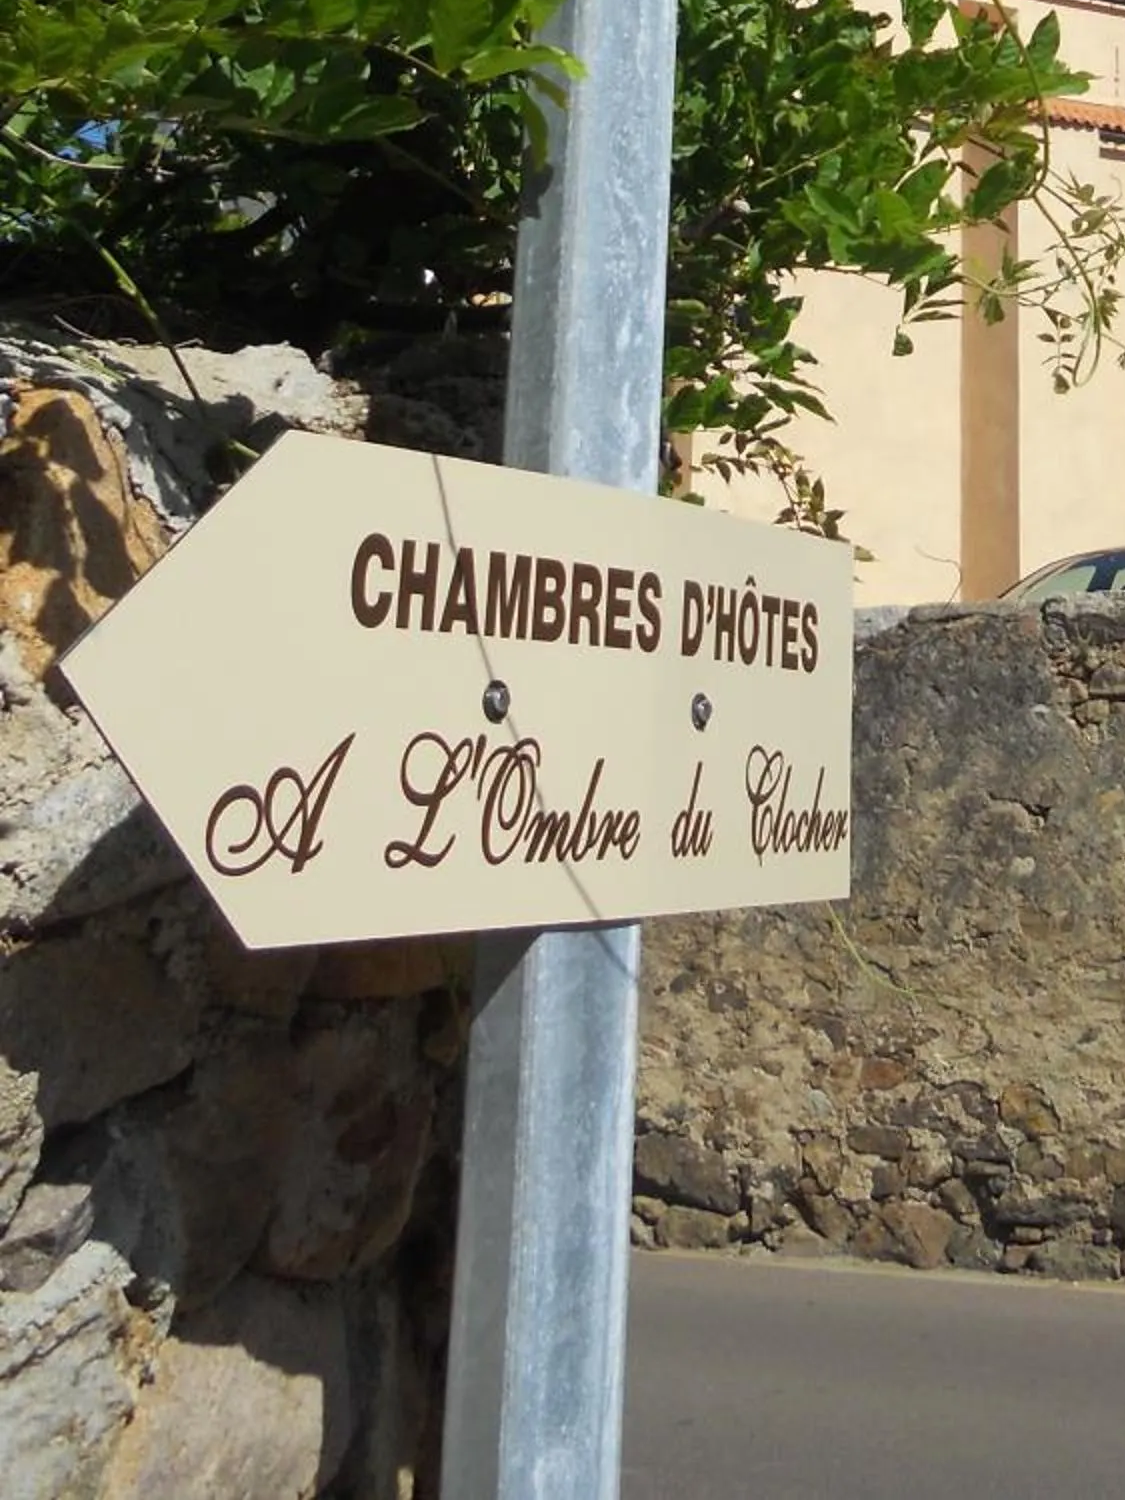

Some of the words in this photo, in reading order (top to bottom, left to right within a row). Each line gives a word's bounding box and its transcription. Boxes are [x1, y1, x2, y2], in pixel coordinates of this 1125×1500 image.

[350, 532, 663, 653] CHAMBRES
[680, 575, 819, 674] D'HÔTES
[205, 732, 356, 877] A
[383, 731, 641, 869] L'Ombre
[670, 761, 713, 859] du
[745, 744, 849, 867] Clocher
